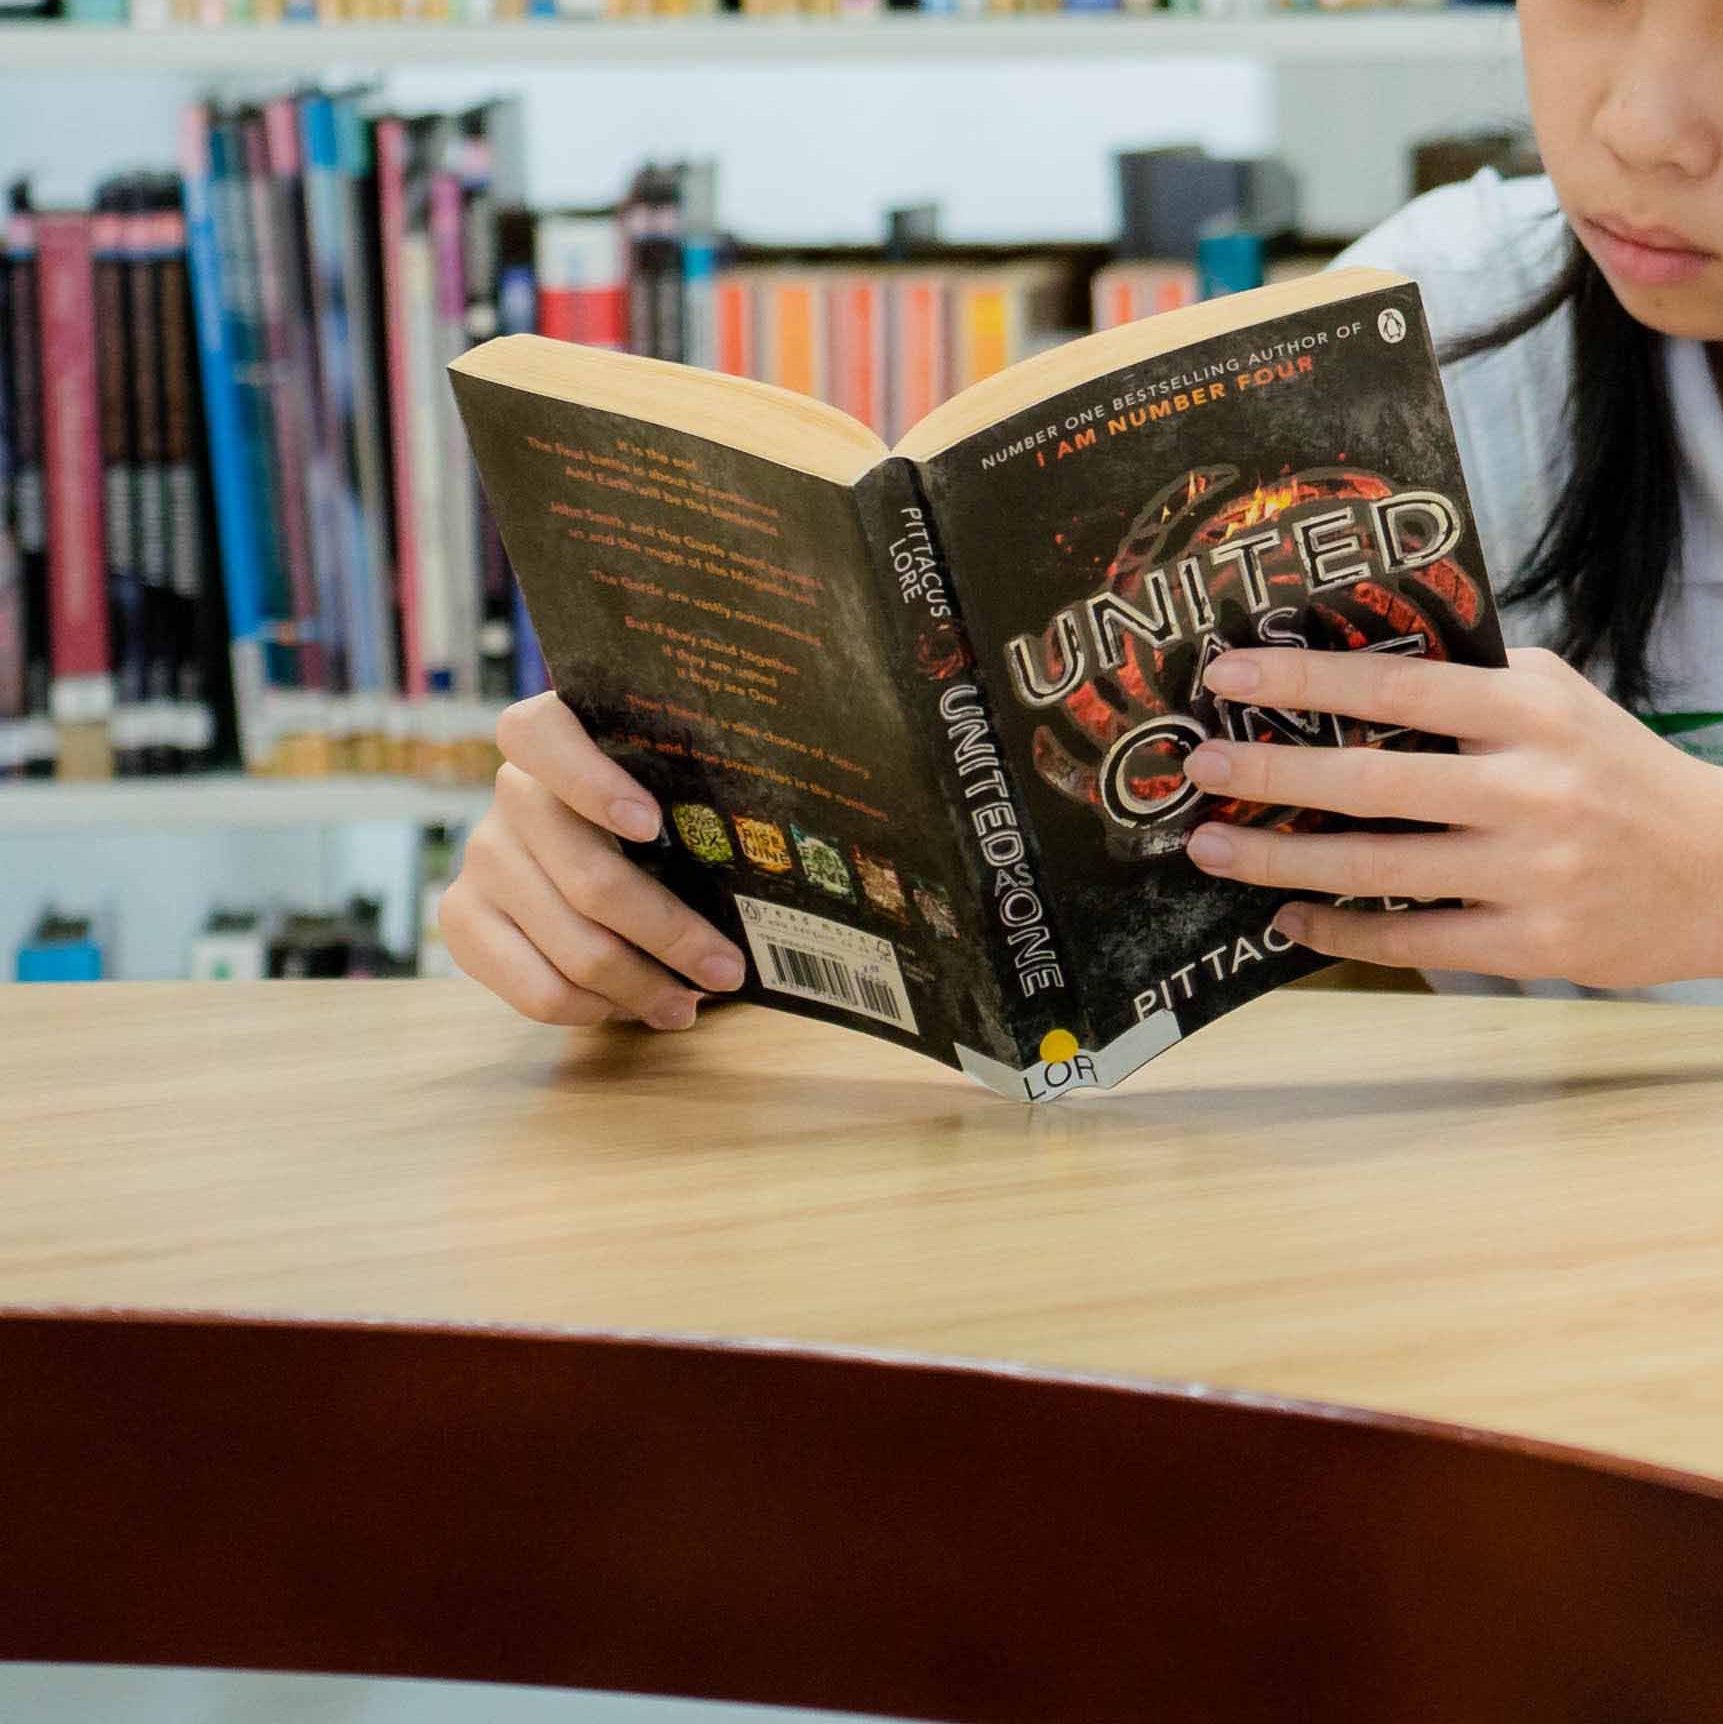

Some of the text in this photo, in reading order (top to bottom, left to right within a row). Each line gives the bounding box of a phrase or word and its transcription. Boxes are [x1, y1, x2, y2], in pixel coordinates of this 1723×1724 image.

[981, 321, 1363, 471] NUMBER ONE BESTSELLING AUTHOR OF
[1035, 355, 1314, 469] I AM NUMBER FOUR
[888, 538, 923, 605] LORE
[900, 506, 952, 619] PITTACUS
[1004, 490, 1463, 709] UNITED
[688, 828, 719, 847] SIX
[938, 682, 1066, 998] UNITED AS ONE
[1023, 1054, 1098, 1102] LOR
